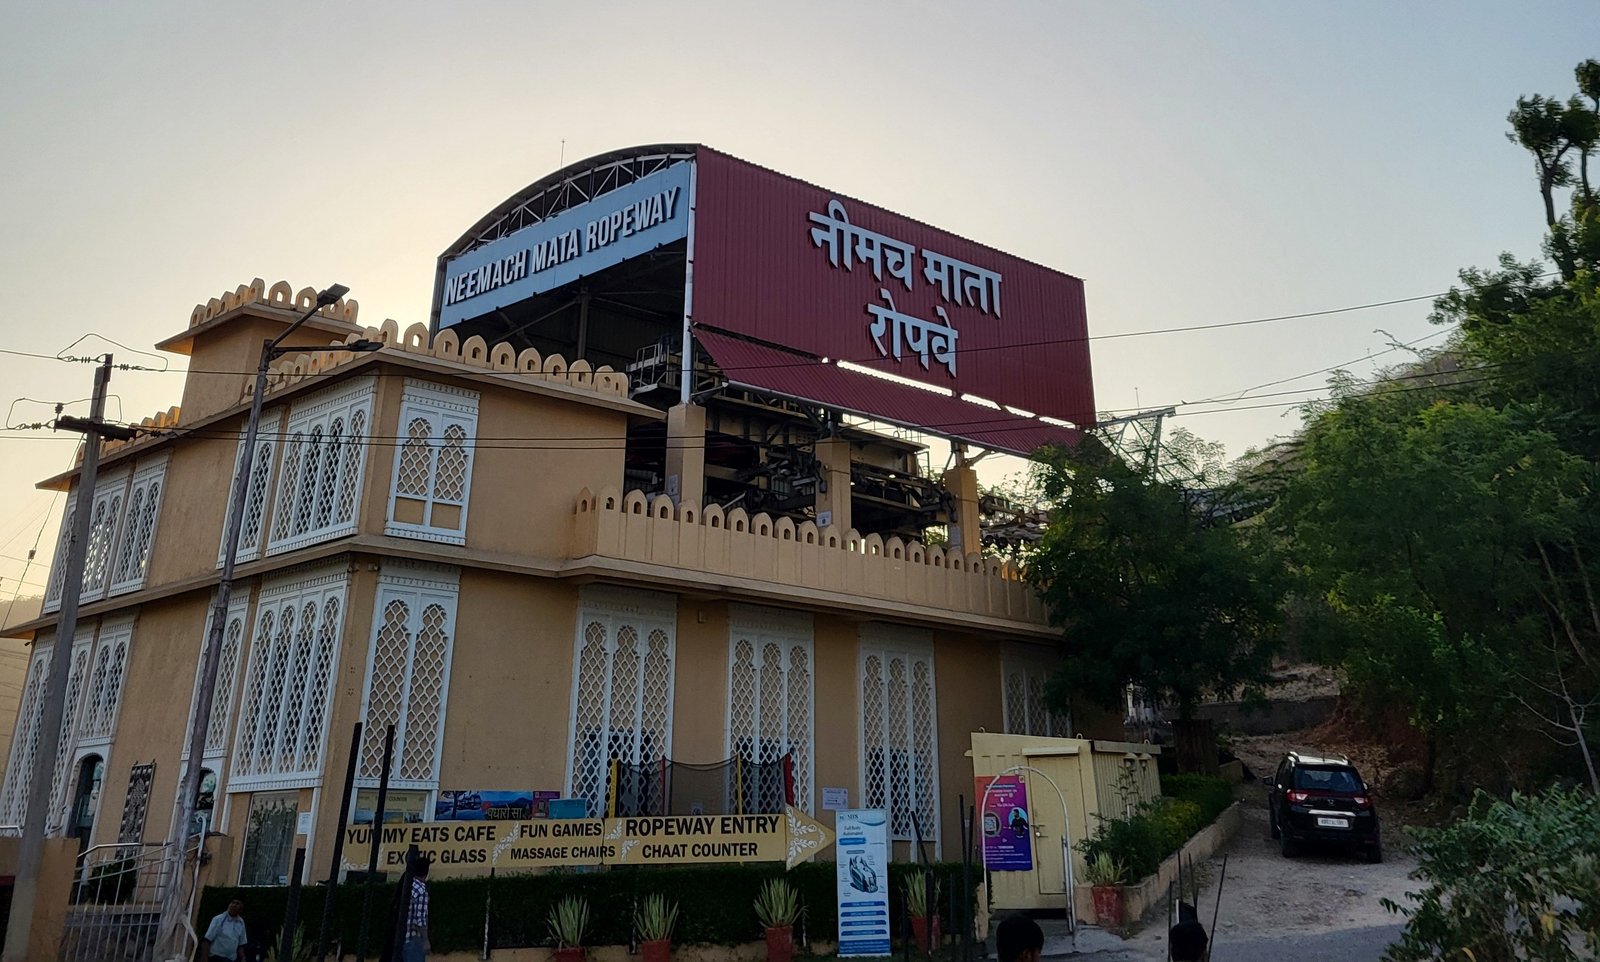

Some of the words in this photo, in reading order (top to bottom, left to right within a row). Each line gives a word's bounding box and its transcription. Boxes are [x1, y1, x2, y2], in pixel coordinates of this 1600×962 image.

[444, 248, 531, 306] NEEMACH
[531, 227, 580, 274] MATA
[585, 186, 681, 252] ROPEWAY
[808, 199, 915, 291] नीमच
[921, 248, 1002, 319] माता
[867, 287, 958, 378] रोपवे
[411, 826, 450, 843] EATS
[454, 825, 496, 842] CAFE
[520, 824, 548, 838] FUN
[552, 822, 602, 837] GAMES
[625, 817, 715, 836] ROPEWAY
[720, 816, 779, 834] ENTRY
[387, 850, 436, 865] EXIC
[440, 849, 487, 863] GLASS
[510, 847, 568, 860] MASSAGE
[571, 846, 615, 859] CHAIRS
[642, 843, 689, 859] CHAAT
[691, 842, 758, 857] COUNTER
